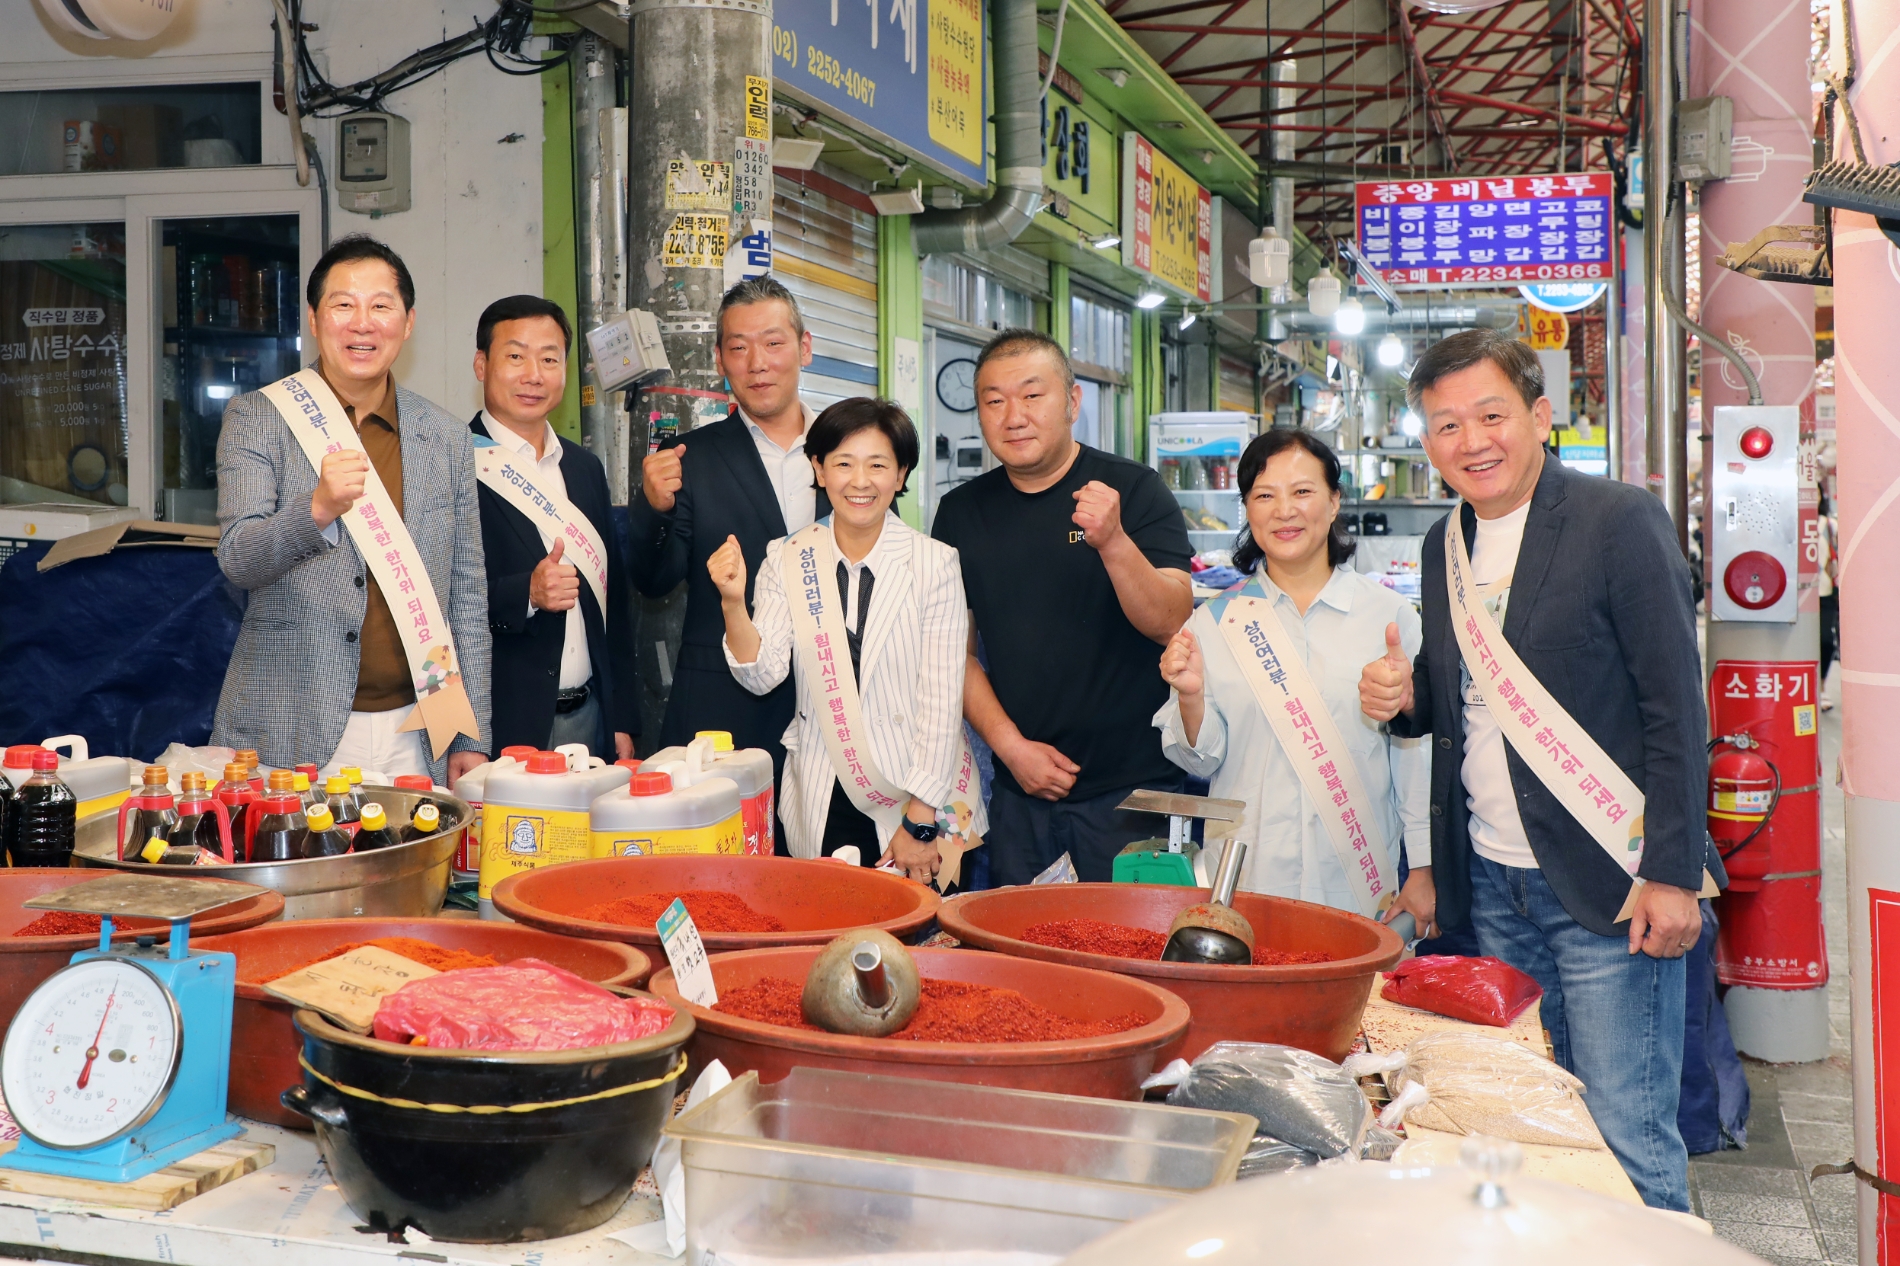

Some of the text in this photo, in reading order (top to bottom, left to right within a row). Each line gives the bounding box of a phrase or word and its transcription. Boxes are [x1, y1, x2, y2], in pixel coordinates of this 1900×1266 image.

[808, 45, 876, 108] 2252-4067
[748, 86, 768, 124] 인력
[937, 97, 965, 138] 부산어묵
[744, 163, 763, 175] 342
[744, 177, 757, 187] 58
[1372, 176, 1596, 204] 중앙 비닐 봉투
[744, 201, 757, 211] R3
[1154, 168, 1197, 261] 지원이네
[1364, 207, 1393, 266] 비닐봉투
[1398, 206, 1427, 265] 종이봉투
[1433, 205, 1462, 264] 김장봉투
[1468, 203, 1497, 263] 양파망
[1503, 201, 1532, 262] 면장갑
[1538, 201, 1568, 261] 고무장갑
[1573, 200, 1605, 260] 코팅장갑
[1376, 264, 1602, 284] 소매 T.2234-0366
[29, 310, 99, 323] 직수입 정품
[30, 334, 127, 362] 사탕수수
[60, 384, 82, 393] CANE
[83, 382, 112, 391] SUGAR
[500, 463, 565, 524] 상인여러분!
[565, 521, 602, 571] 힘내시고
[358, 502, 393, 547] 행복한
[384, 549, 416, 595] 한가위
[407, 597, 433, 645] 되세요
[799, 545, 825, 629] 상인여러분!
[813, 632, 841, 694] 힘내시고
[827, 697, 852, 744] 행복한
[843, 747, 872, 789] 한가위
[1724, 672, 1809, 702] 소화기
[1465, 614, 1503, 681] 힘내시고
[1497, 677, 1540, 729] 행복한
[1535, 726, 1584, 775] 한가위
[1578, 773, 1628, 825] 되세요
[955, 750, 973, 796] 되세요
[1244, 620, 1384, 898] 상인여러분! 힘내시고 행복한 한가위 되세요
[45, 1022, 55, 1036] 4
[45, 1090, 56, 1105] 3
[106, 1098, 118, 1112] 2
